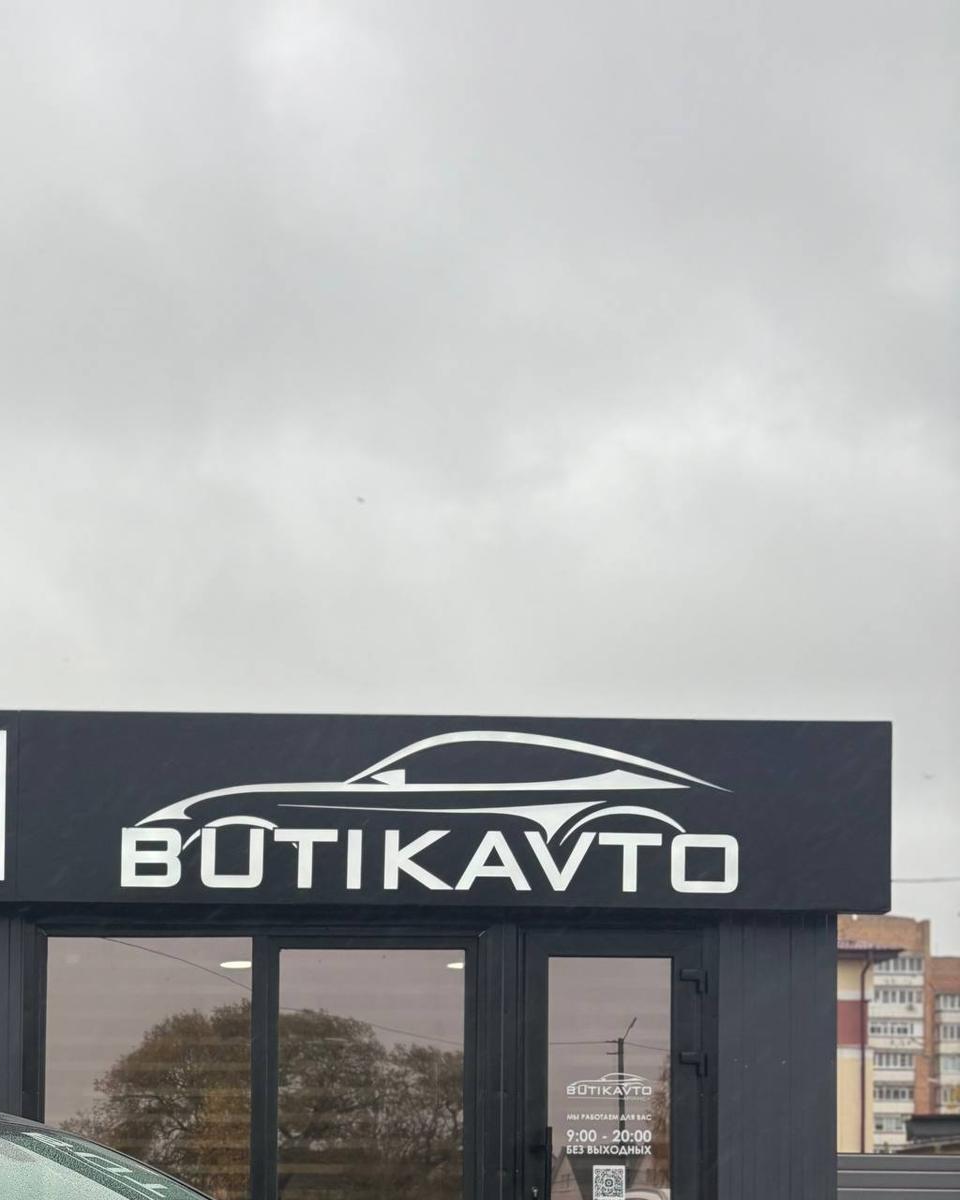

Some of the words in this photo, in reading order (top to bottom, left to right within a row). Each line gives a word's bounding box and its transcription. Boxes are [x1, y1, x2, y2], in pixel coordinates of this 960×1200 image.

[120, 826, 740, 894] BUTIKAVTO
[566, 1085, 652, 1096] BUTIKAVTO
[566, 1129, 597, 1143] 9:00
[612, 1129, 652, 1143] 20:00
[566, 1144, 585, 1155] БЕЗ
[587, 1144, 652, 1155] ВЫХОДНЫХ
